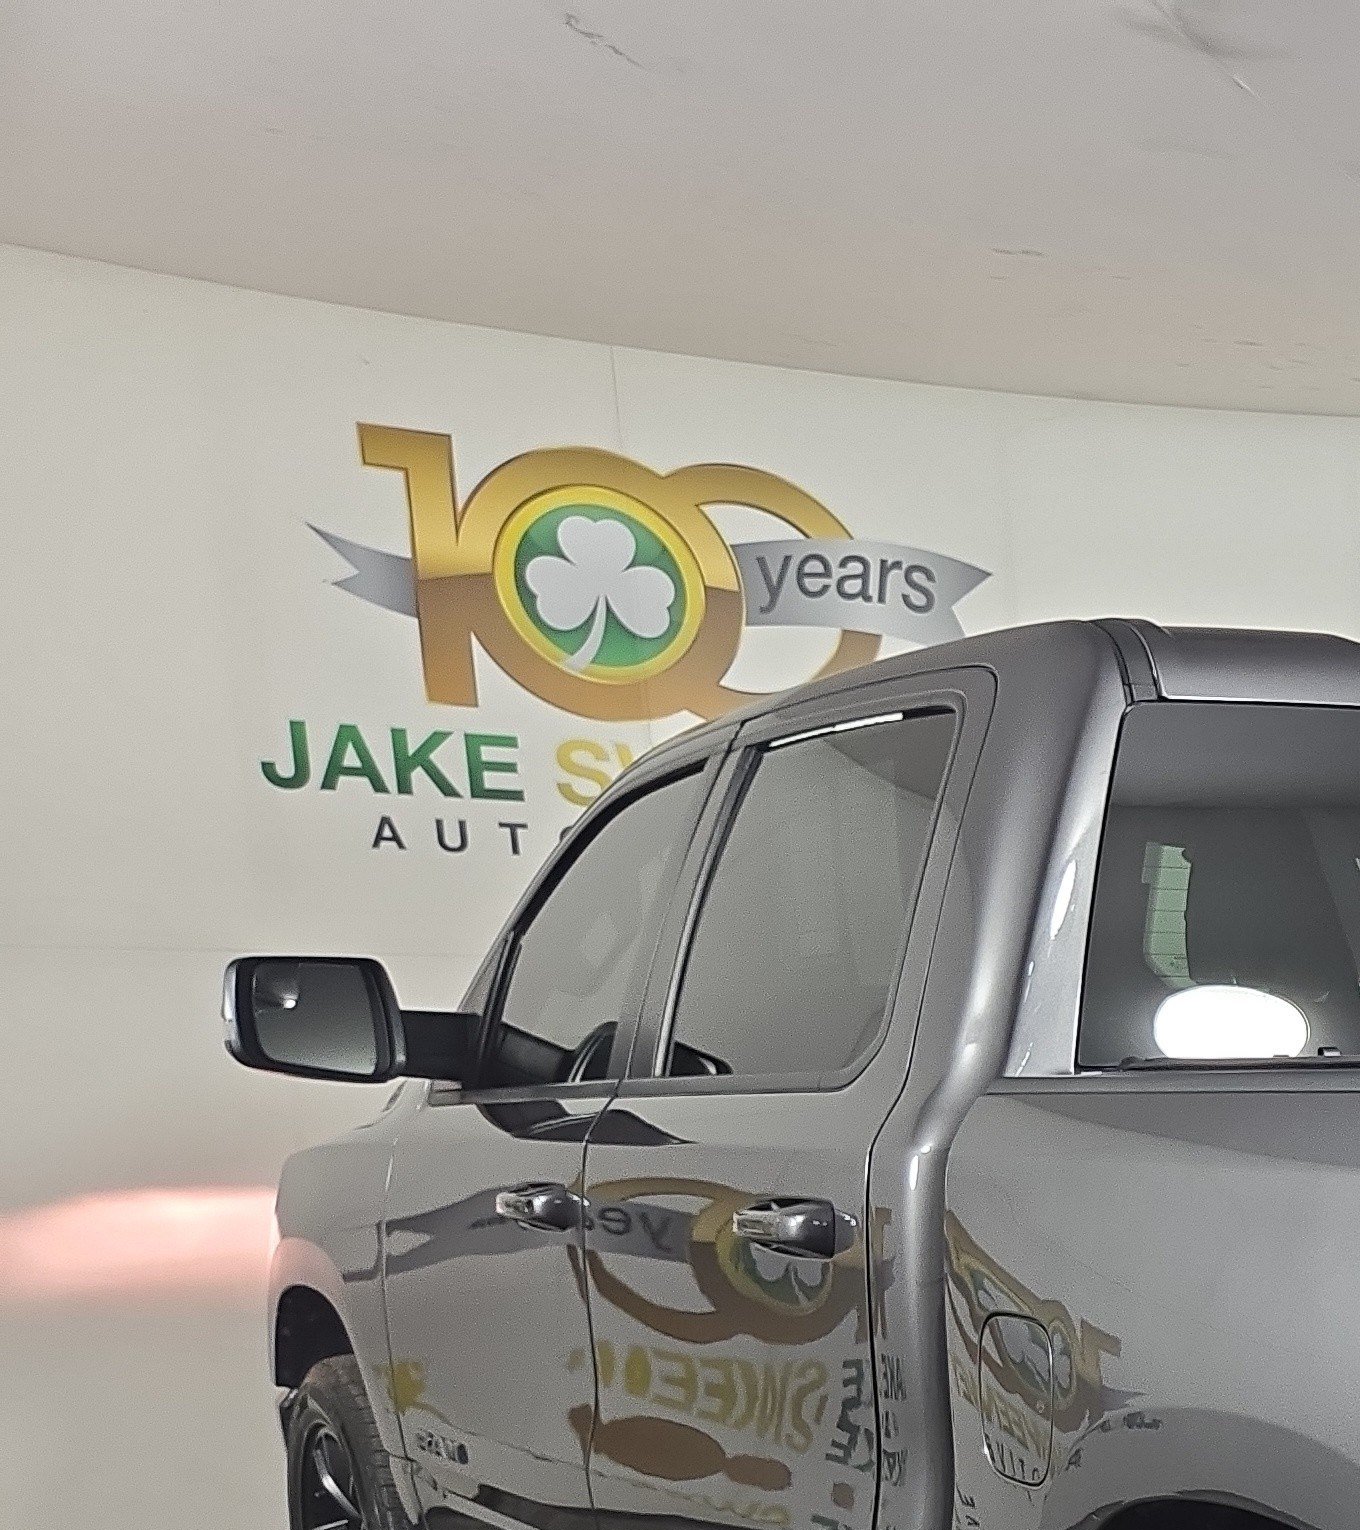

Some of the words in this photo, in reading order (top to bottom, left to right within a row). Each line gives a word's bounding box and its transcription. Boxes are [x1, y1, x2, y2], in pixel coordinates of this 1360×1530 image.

[755, 548, 938, 614] years
[261, 720, 525, 801] JAKE
[555, 738, 636, 807] S
[372, 816, 574, 855] AUT
